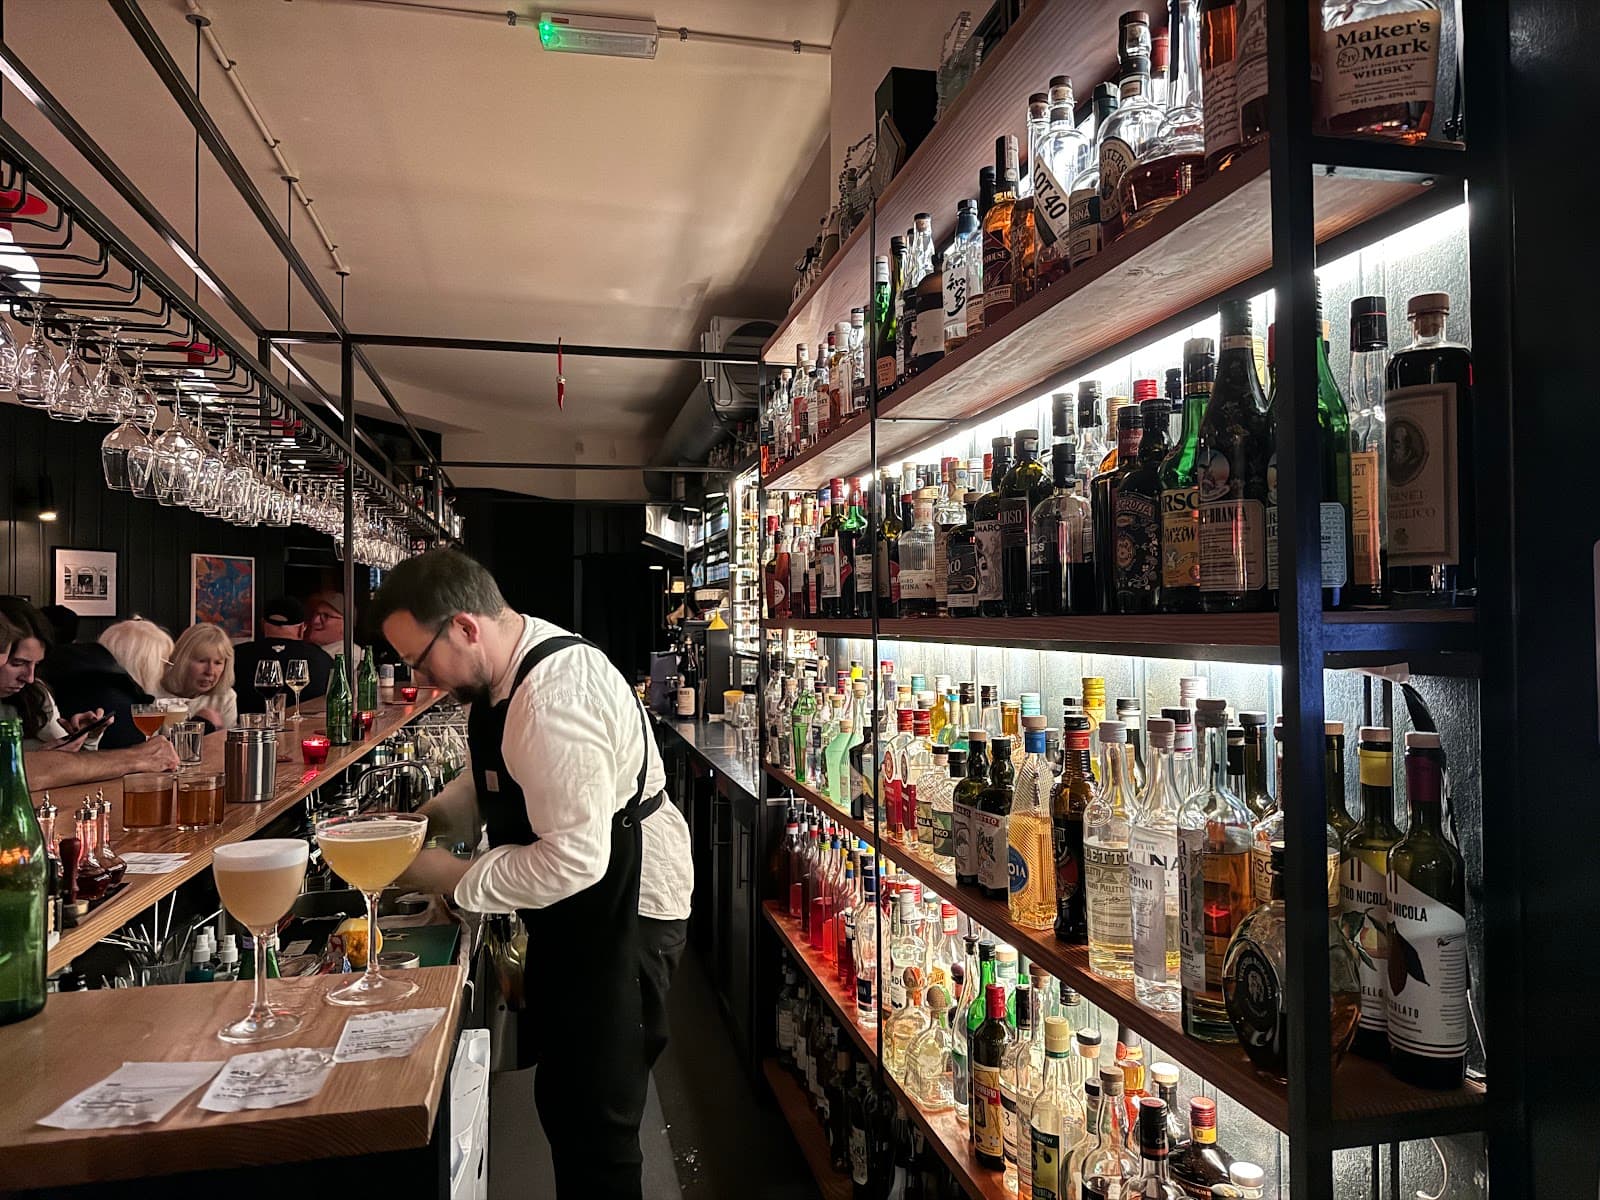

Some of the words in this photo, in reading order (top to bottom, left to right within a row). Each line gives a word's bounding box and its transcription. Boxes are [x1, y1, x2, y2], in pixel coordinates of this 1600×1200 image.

[1335, 19, 1431, 49] Maker's
[1361, 38, 1430, 62] Mark
[1352, 62, 1416, 80] WHISKY
[1034, 162, 1054, 198] LOT
[1044, 194, 1068, 220] 40
[1393, 903, 1429, 922] NICOLA
